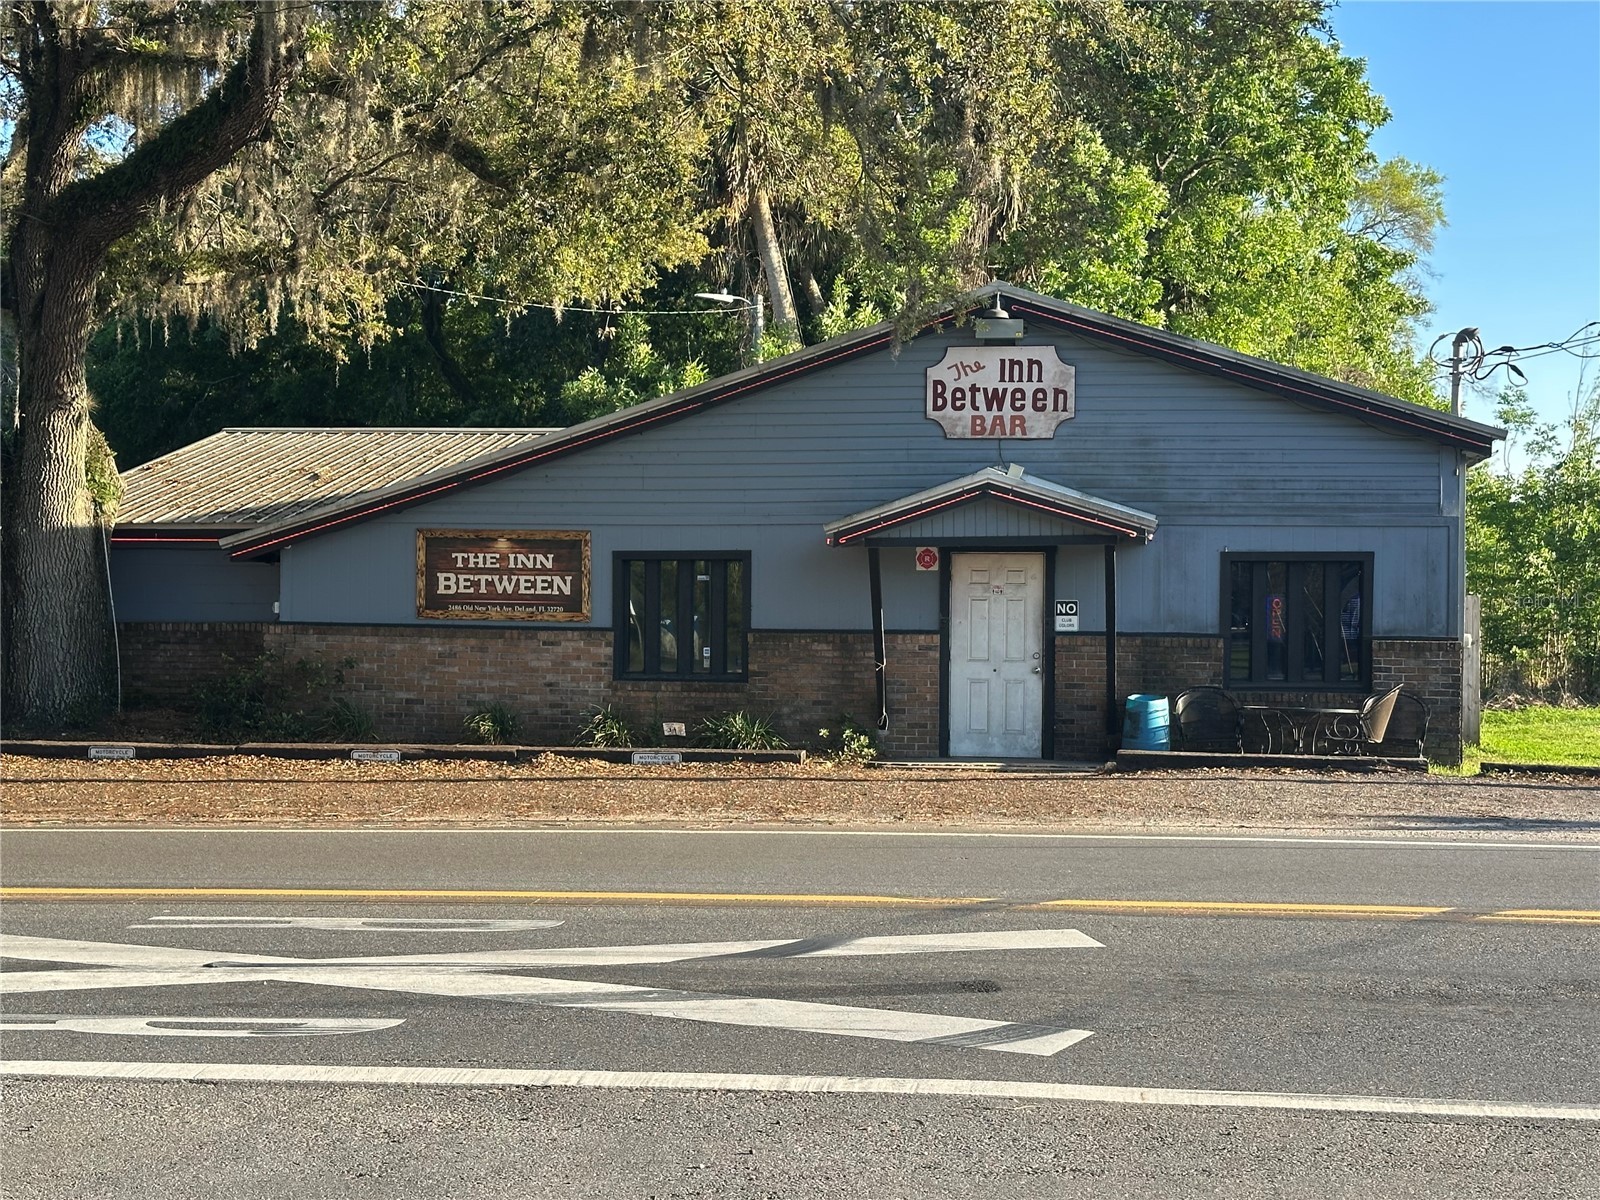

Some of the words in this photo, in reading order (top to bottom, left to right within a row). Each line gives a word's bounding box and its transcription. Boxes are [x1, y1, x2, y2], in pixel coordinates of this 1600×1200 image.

[947, 360, 986, 382] The
[932, 379, 1068, 412] Between
[970, 415, 1027, 436] BAR
[452, 552, 500, 568] THE
[508, 553, 554, 569] INN
[924, 555, 931, 563] R
[437, 572, 572, 595] BETWEEN
[1057, 603, 1076, 614] NO
